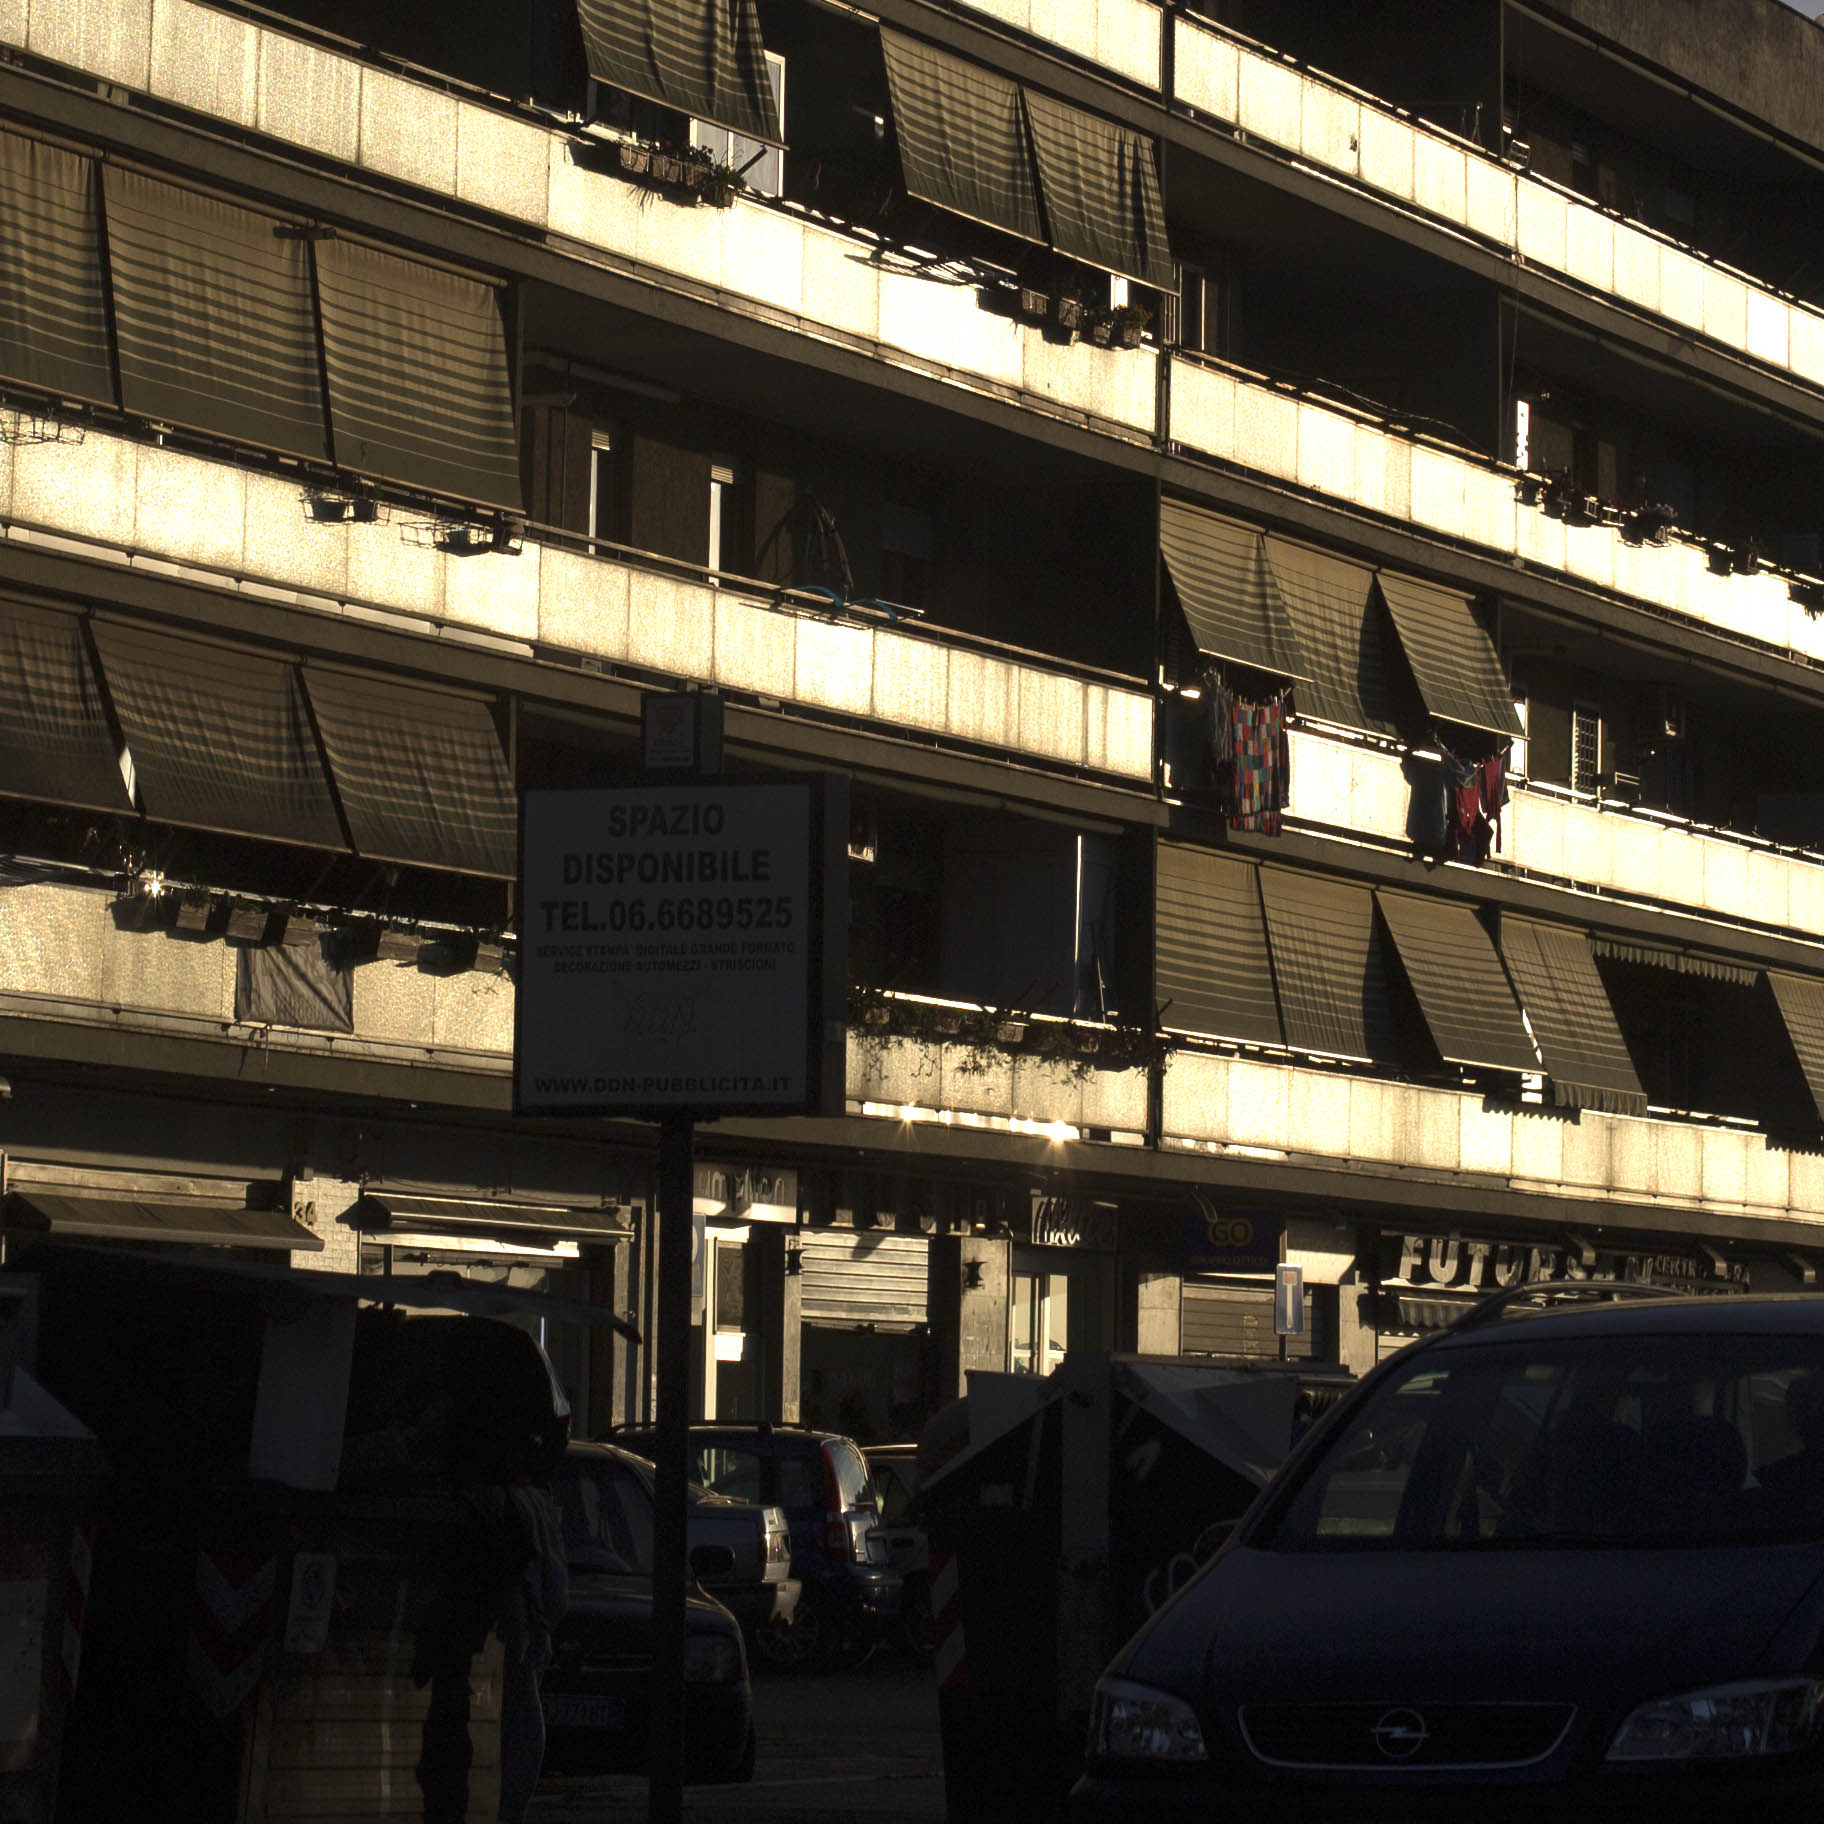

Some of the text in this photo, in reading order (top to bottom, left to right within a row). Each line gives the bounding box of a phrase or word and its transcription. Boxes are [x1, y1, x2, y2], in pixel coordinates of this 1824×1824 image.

[608, 803, 725, 837] SPAZIO
[563, 850, 770, 885] DISPONIBILE
[536, 944, 583, 958] SERVICE
[637, 943, 687, 956] DIGITALE
[690, 943, 737, 955] GRANDE
[741, 941, 795, 954] FORMATO
[553, 958, 777, 974] DECORAZIONE AUTOMEZZI STRISCIONI
